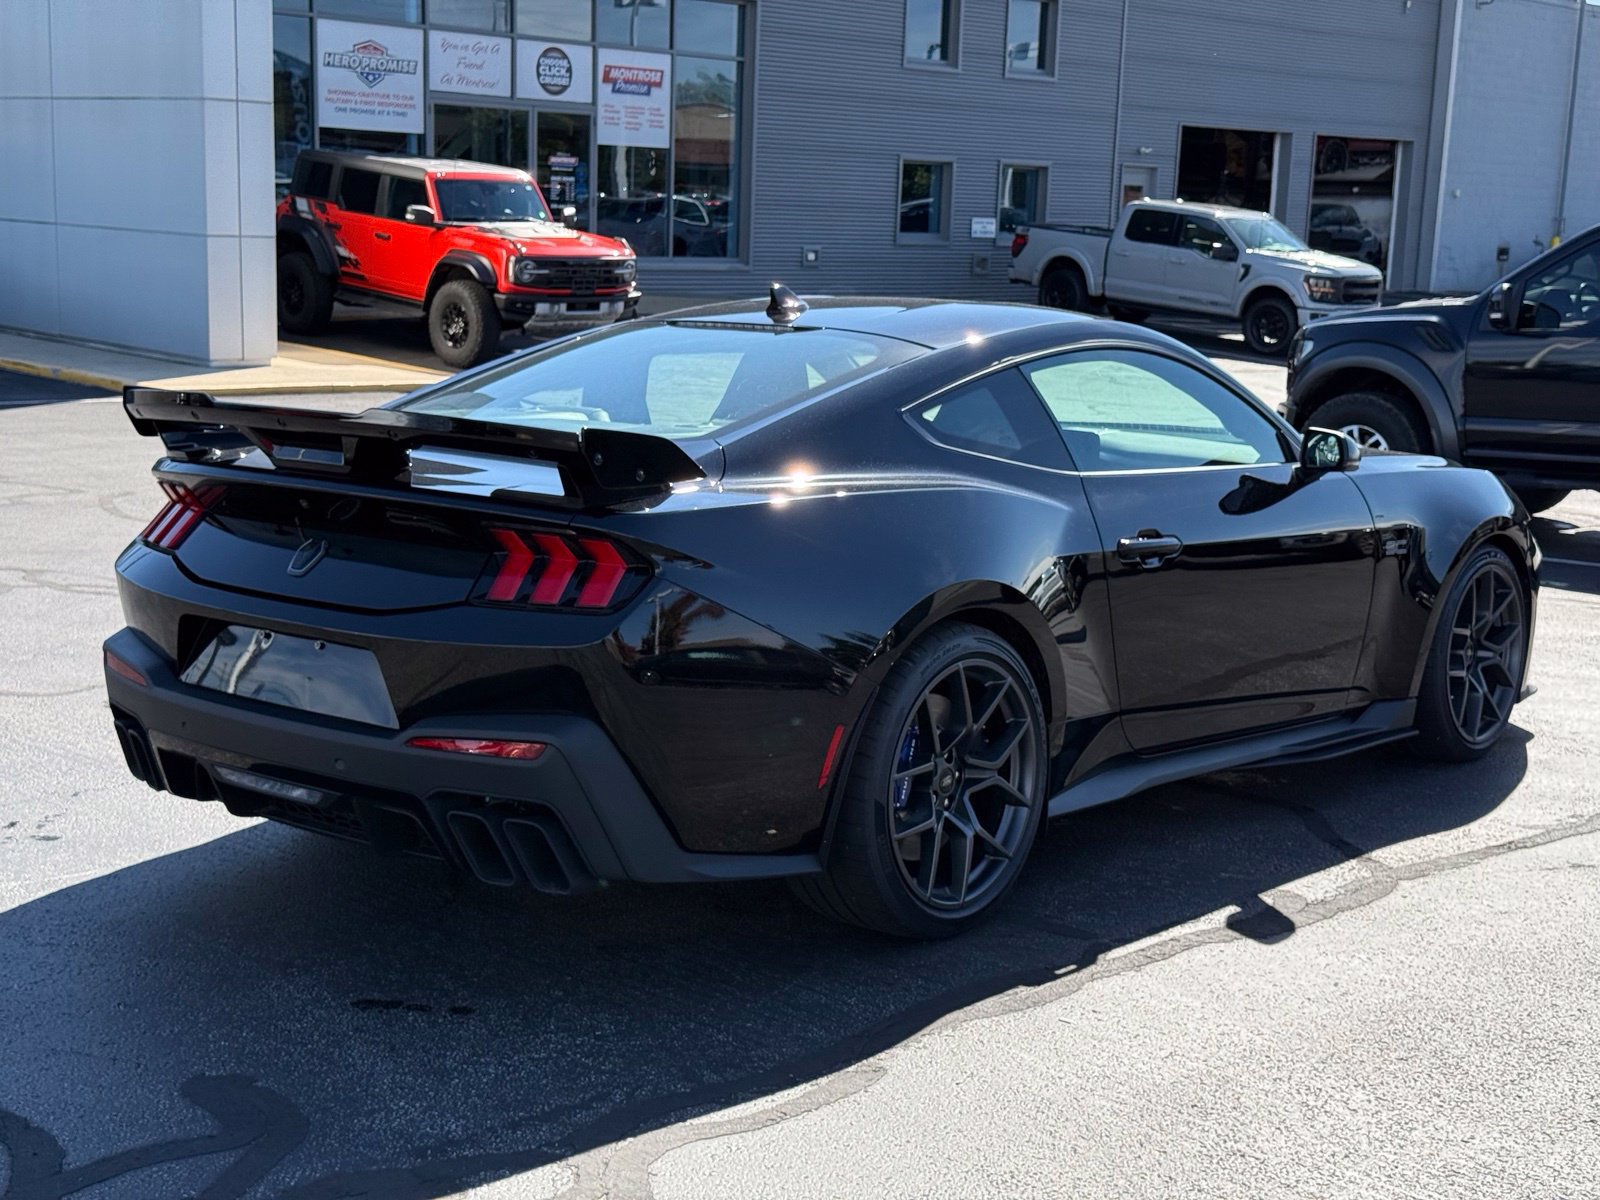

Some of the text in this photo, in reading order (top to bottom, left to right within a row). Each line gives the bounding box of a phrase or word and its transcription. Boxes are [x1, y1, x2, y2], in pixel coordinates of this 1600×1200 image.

[324, 53, 417, 73] HERO PROMISE
[609, 68, 662, 83] MONTROSE
